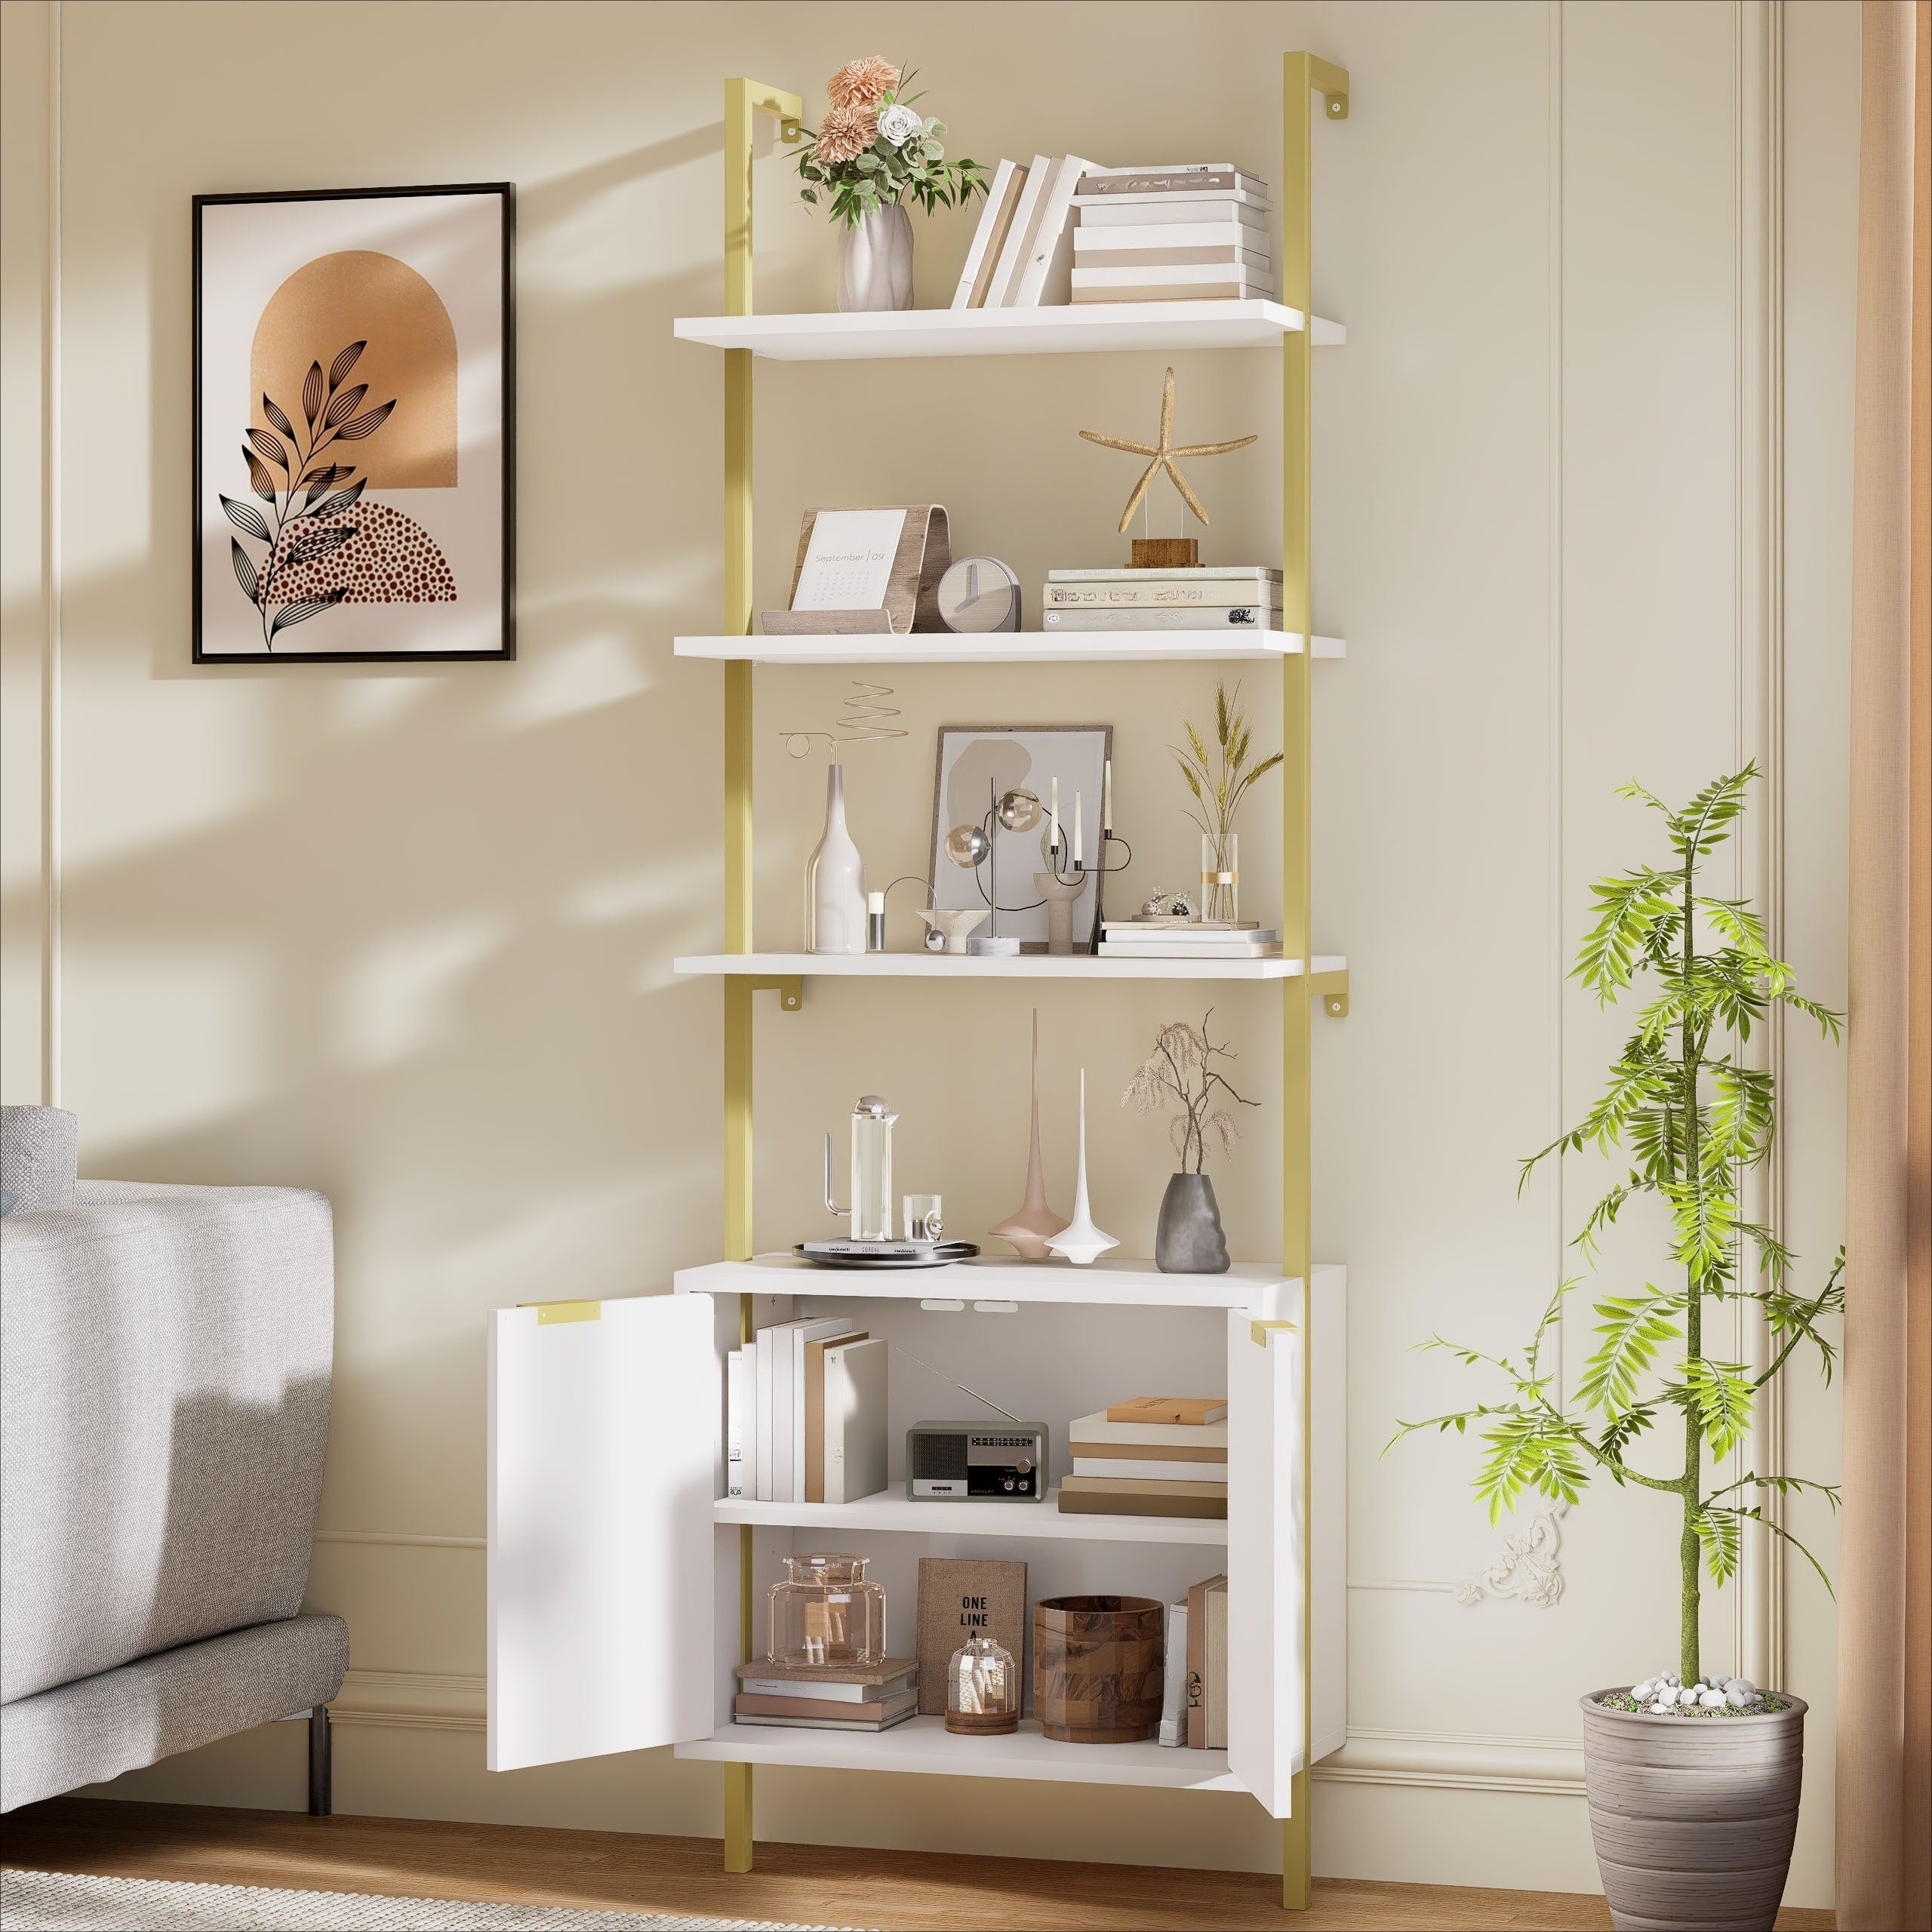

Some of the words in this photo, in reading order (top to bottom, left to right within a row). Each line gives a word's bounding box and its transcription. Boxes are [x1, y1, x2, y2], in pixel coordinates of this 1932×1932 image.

[815, 554, 864, 563] September
[962, 1597, 987, 1609] ONE
[960, 1614, 988, 1626] LINE
[970, 1630, 977, 1644] A
